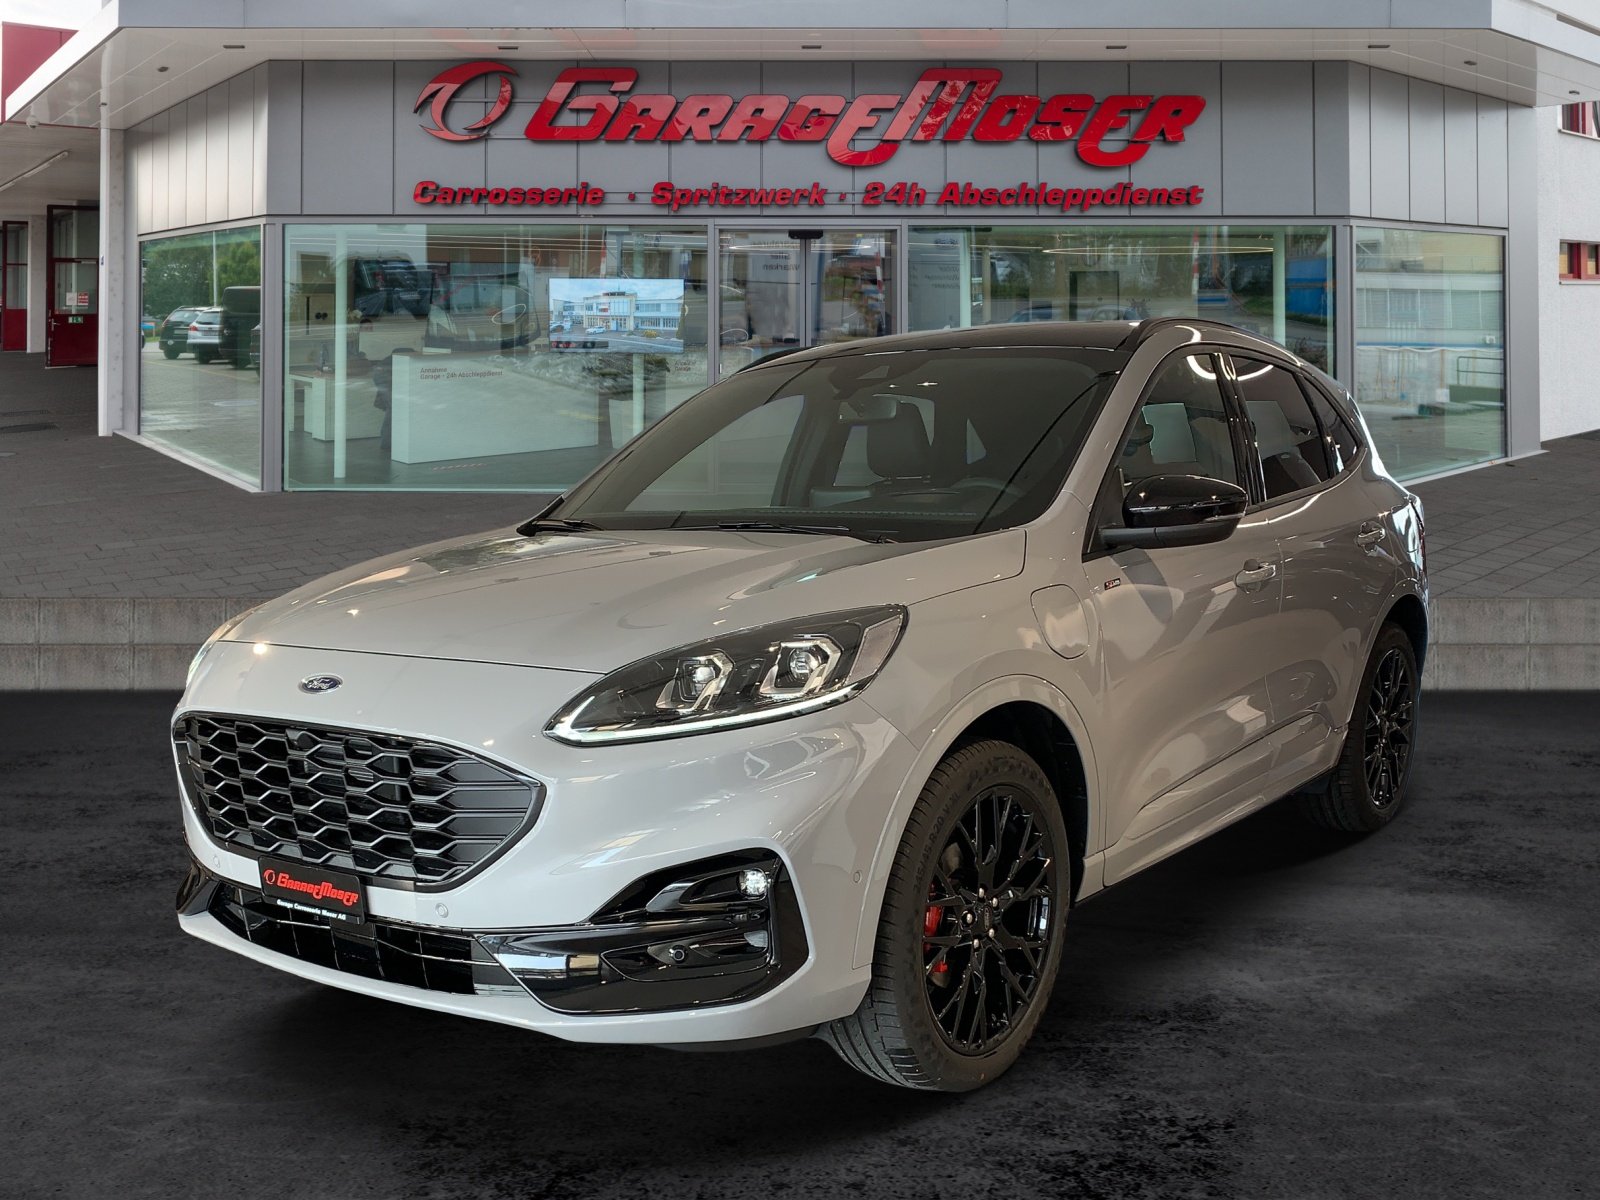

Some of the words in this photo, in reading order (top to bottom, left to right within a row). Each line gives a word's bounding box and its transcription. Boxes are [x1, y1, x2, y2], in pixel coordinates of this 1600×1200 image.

[413, 181, 604, 206] Carrosserie
[651, 182, 826, 211] Spritzwerk
[862, 182, 926, 206] 24h
[936, 182, 1204, 211] Abschleppdienst
[458, 370, 503, 379] Abschleppdienst
[276, 899, 293, 909] Garage
[294, 903, 321, 914] Carrosserie
[321, 909, 337, 918] Moser
